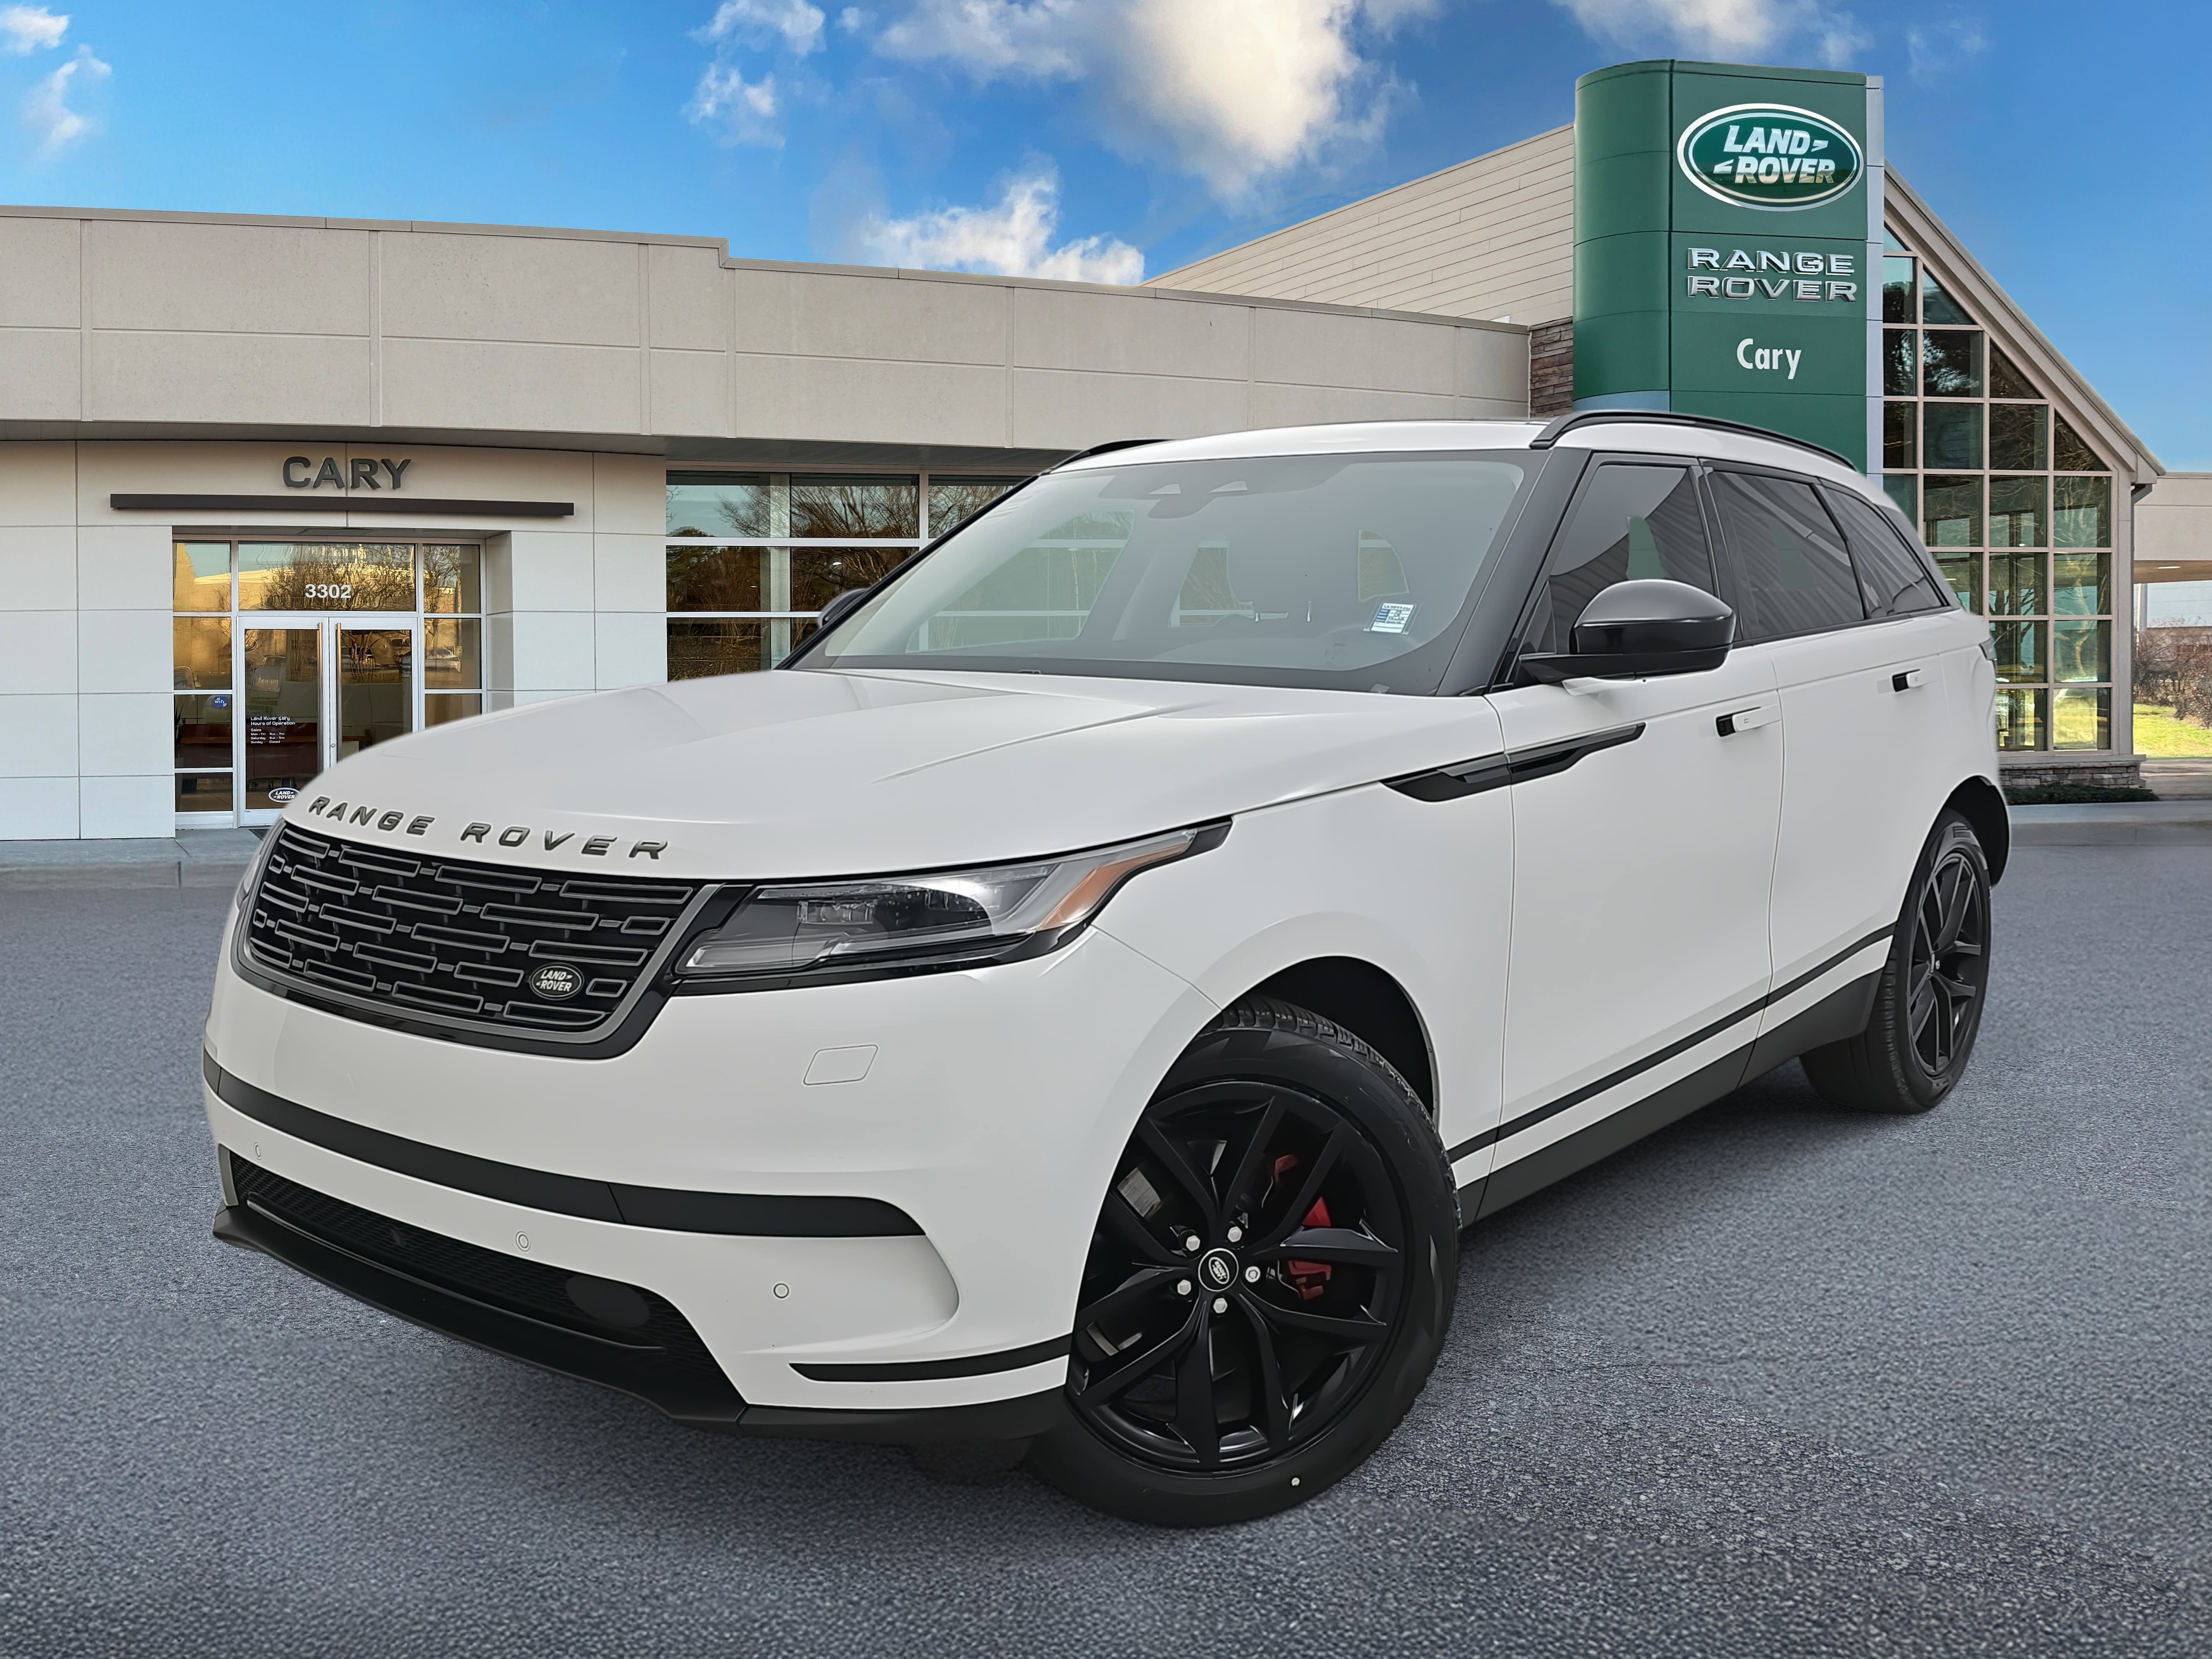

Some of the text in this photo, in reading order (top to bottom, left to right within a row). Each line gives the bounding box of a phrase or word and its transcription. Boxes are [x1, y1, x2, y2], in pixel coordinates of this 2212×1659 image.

[1723, 125, 1810, 155] LAND
[1735, 156, 1835, 184] ROVER
[1688, 248, 1855, 276] RANGE
[1688, 276, 1858, 302] ROVER
[1736, 338, 1802, 380] Cary
[283, 456, 412, 489] CARY
[305, 584, 352, 599] 3302
[308, 796, 668, 860] RANGE ROVER
[540, 969, 567, 981] LAND
[540, 979, 572, 992] ROVER
